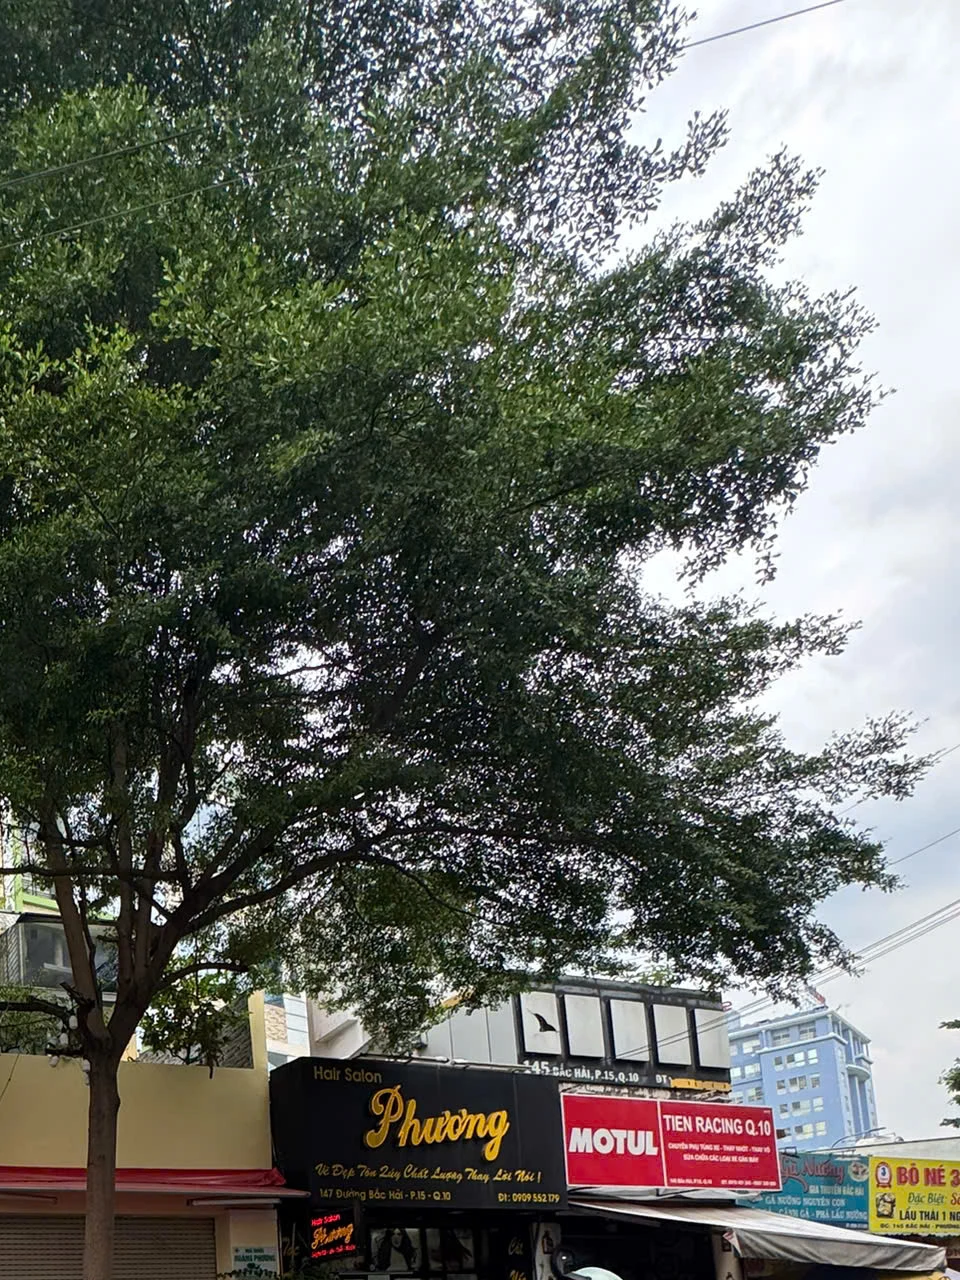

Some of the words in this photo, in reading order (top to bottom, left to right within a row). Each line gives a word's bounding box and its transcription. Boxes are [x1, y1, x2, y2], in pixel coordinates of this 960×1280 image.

[314, 1066, 340, 1080] Hair
[344, 1067, 382, 1083] Salon
[523, 1059, 550, 1076] 145
[365, 1084, 510, 1162] Phương
[663, 1114, 692, 1132] TIEN
[696, 1117, 743, 1135] RACING
[745, 1120, 771, 1137] Q.10
[569, 1127, 658, 1156] MOTUL
[465, 1167, 490, 1184] Thay
[896, 1162, 920, 1186] BÒ
[924, 1164, 946, 1187] NÉ
[320, 1188, 333, 1198] 147
[336, 1188, 366, 1201] Đường
[512, 1193, 532, 1202] 0909
[832, 1198, 846, 1207] CON
